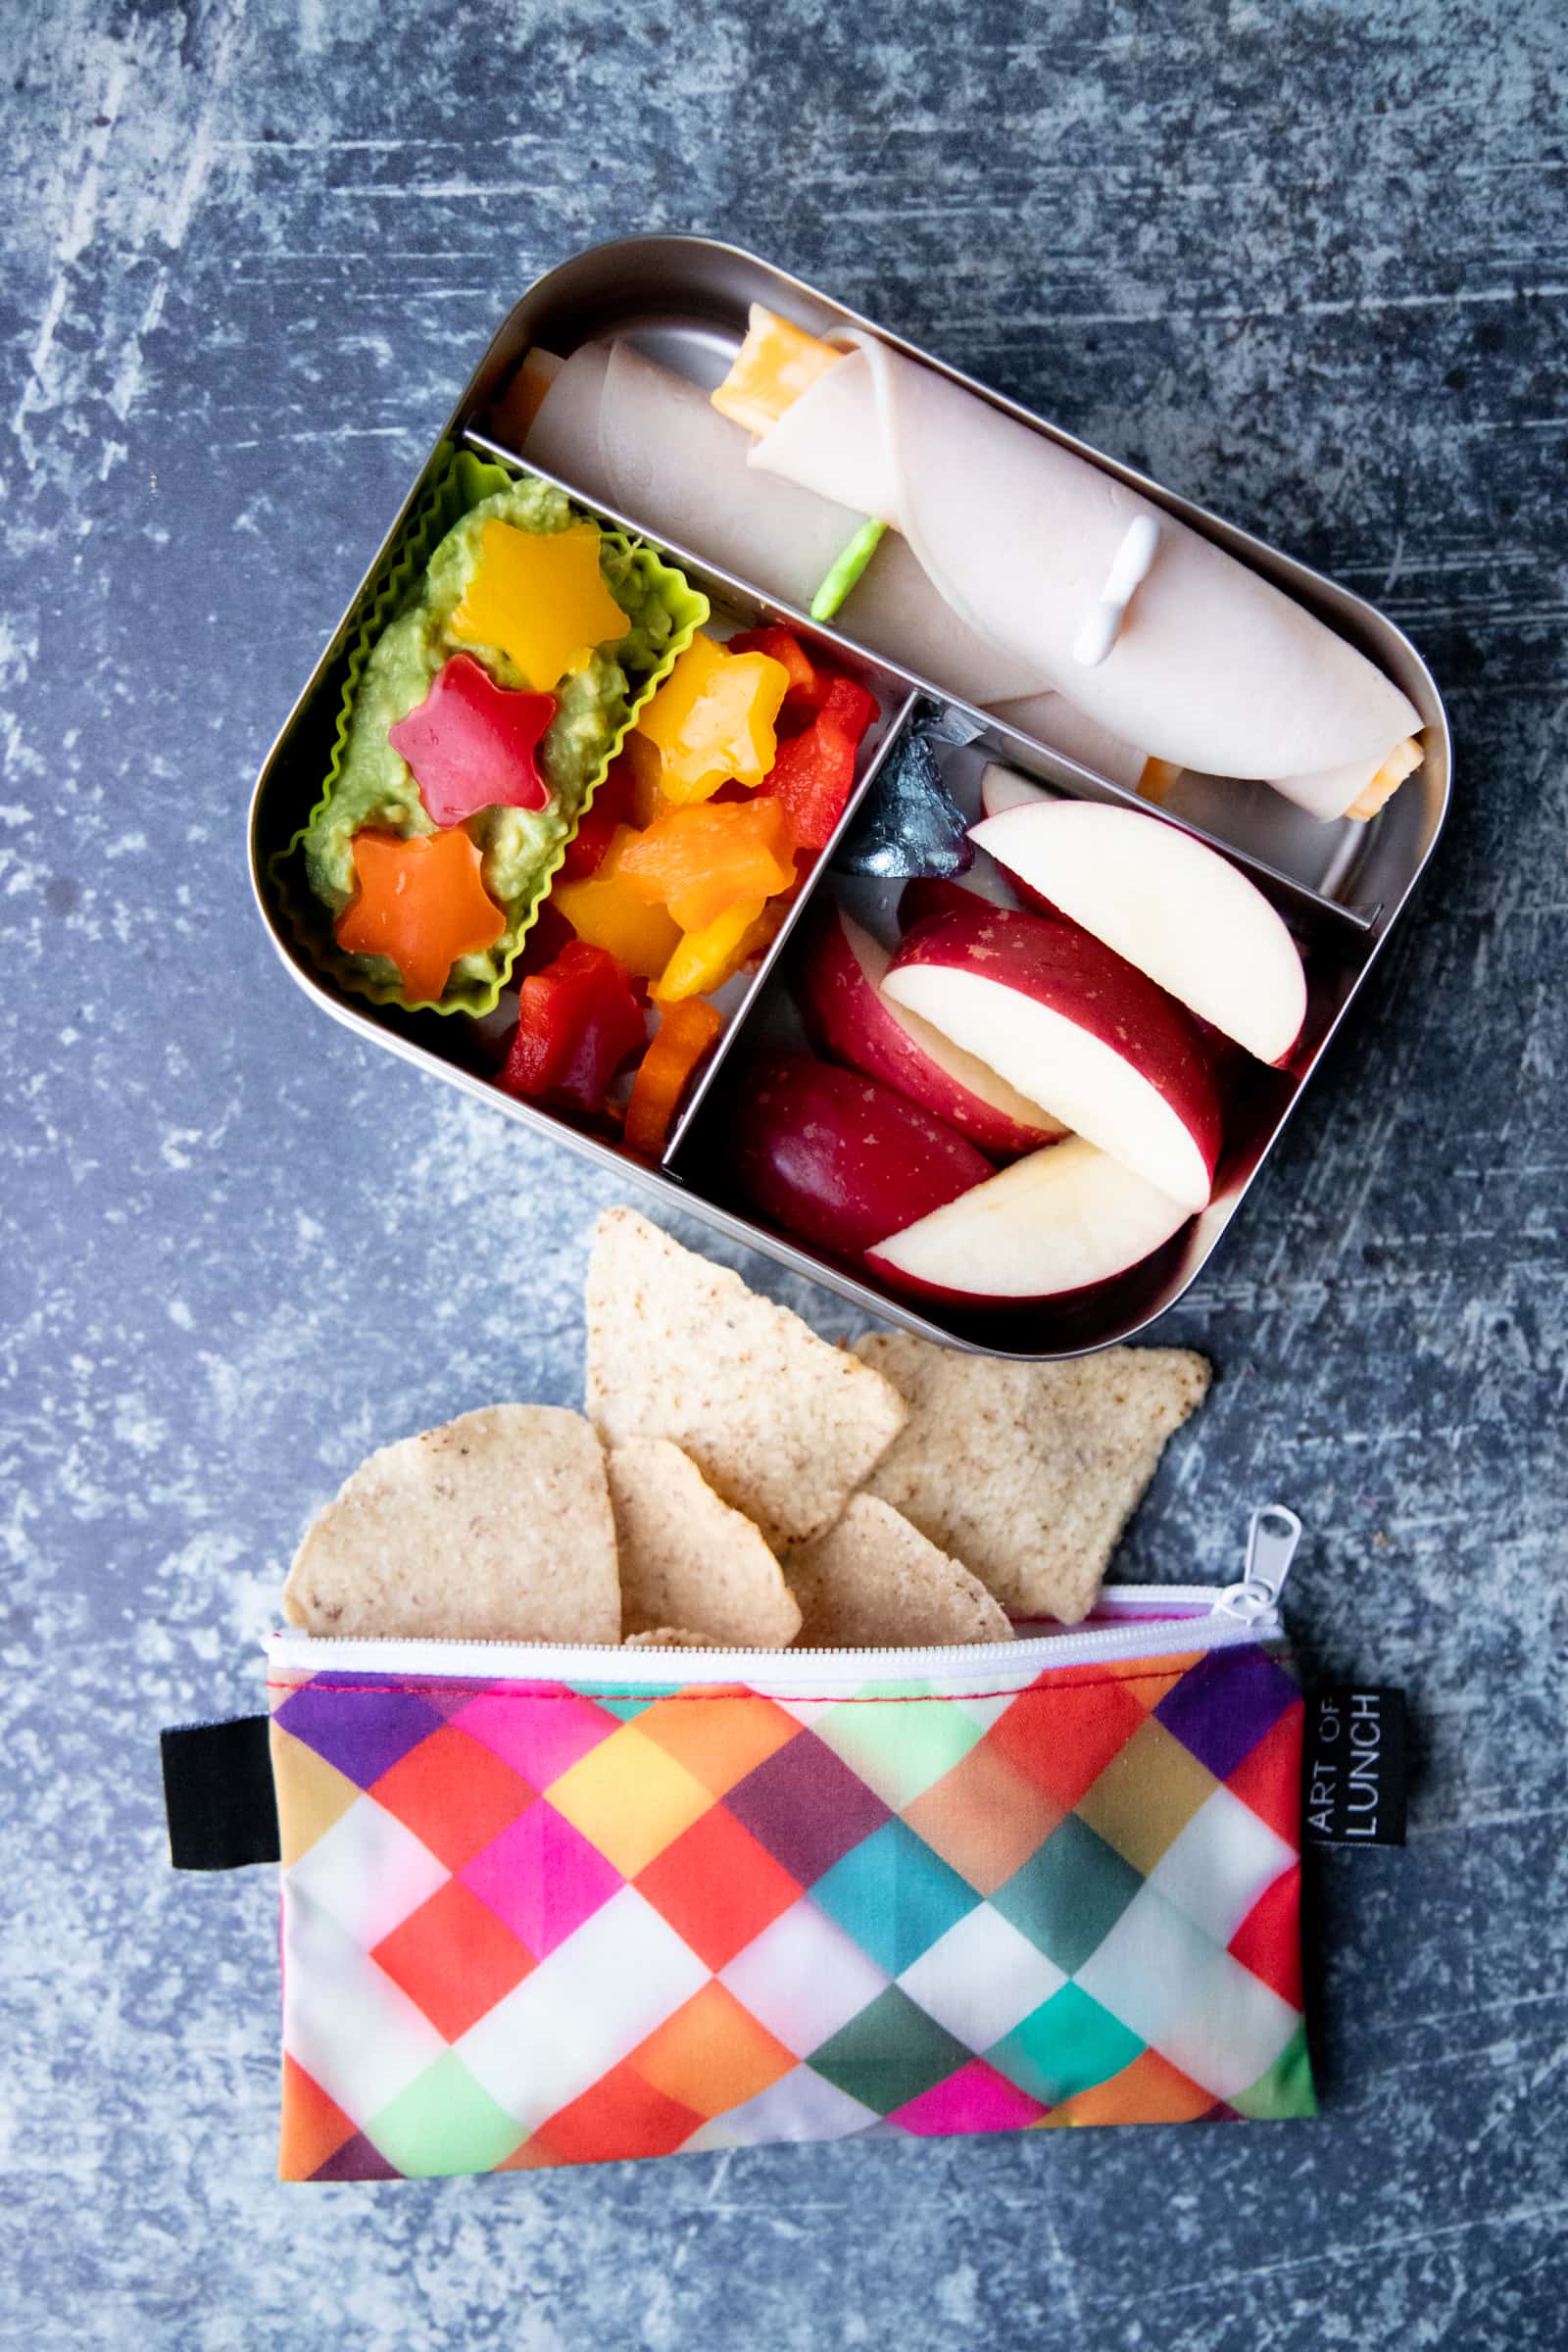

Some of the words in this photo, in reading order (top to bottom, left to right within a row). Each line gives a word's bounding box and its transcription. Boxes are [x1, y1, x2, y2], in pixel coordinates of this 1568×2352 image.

[1319, 1696, 1341, 1742] OF
[1306, 1759, 1337, 1834] ART
[1345, 1694, 1380, 1836] LUNCH
